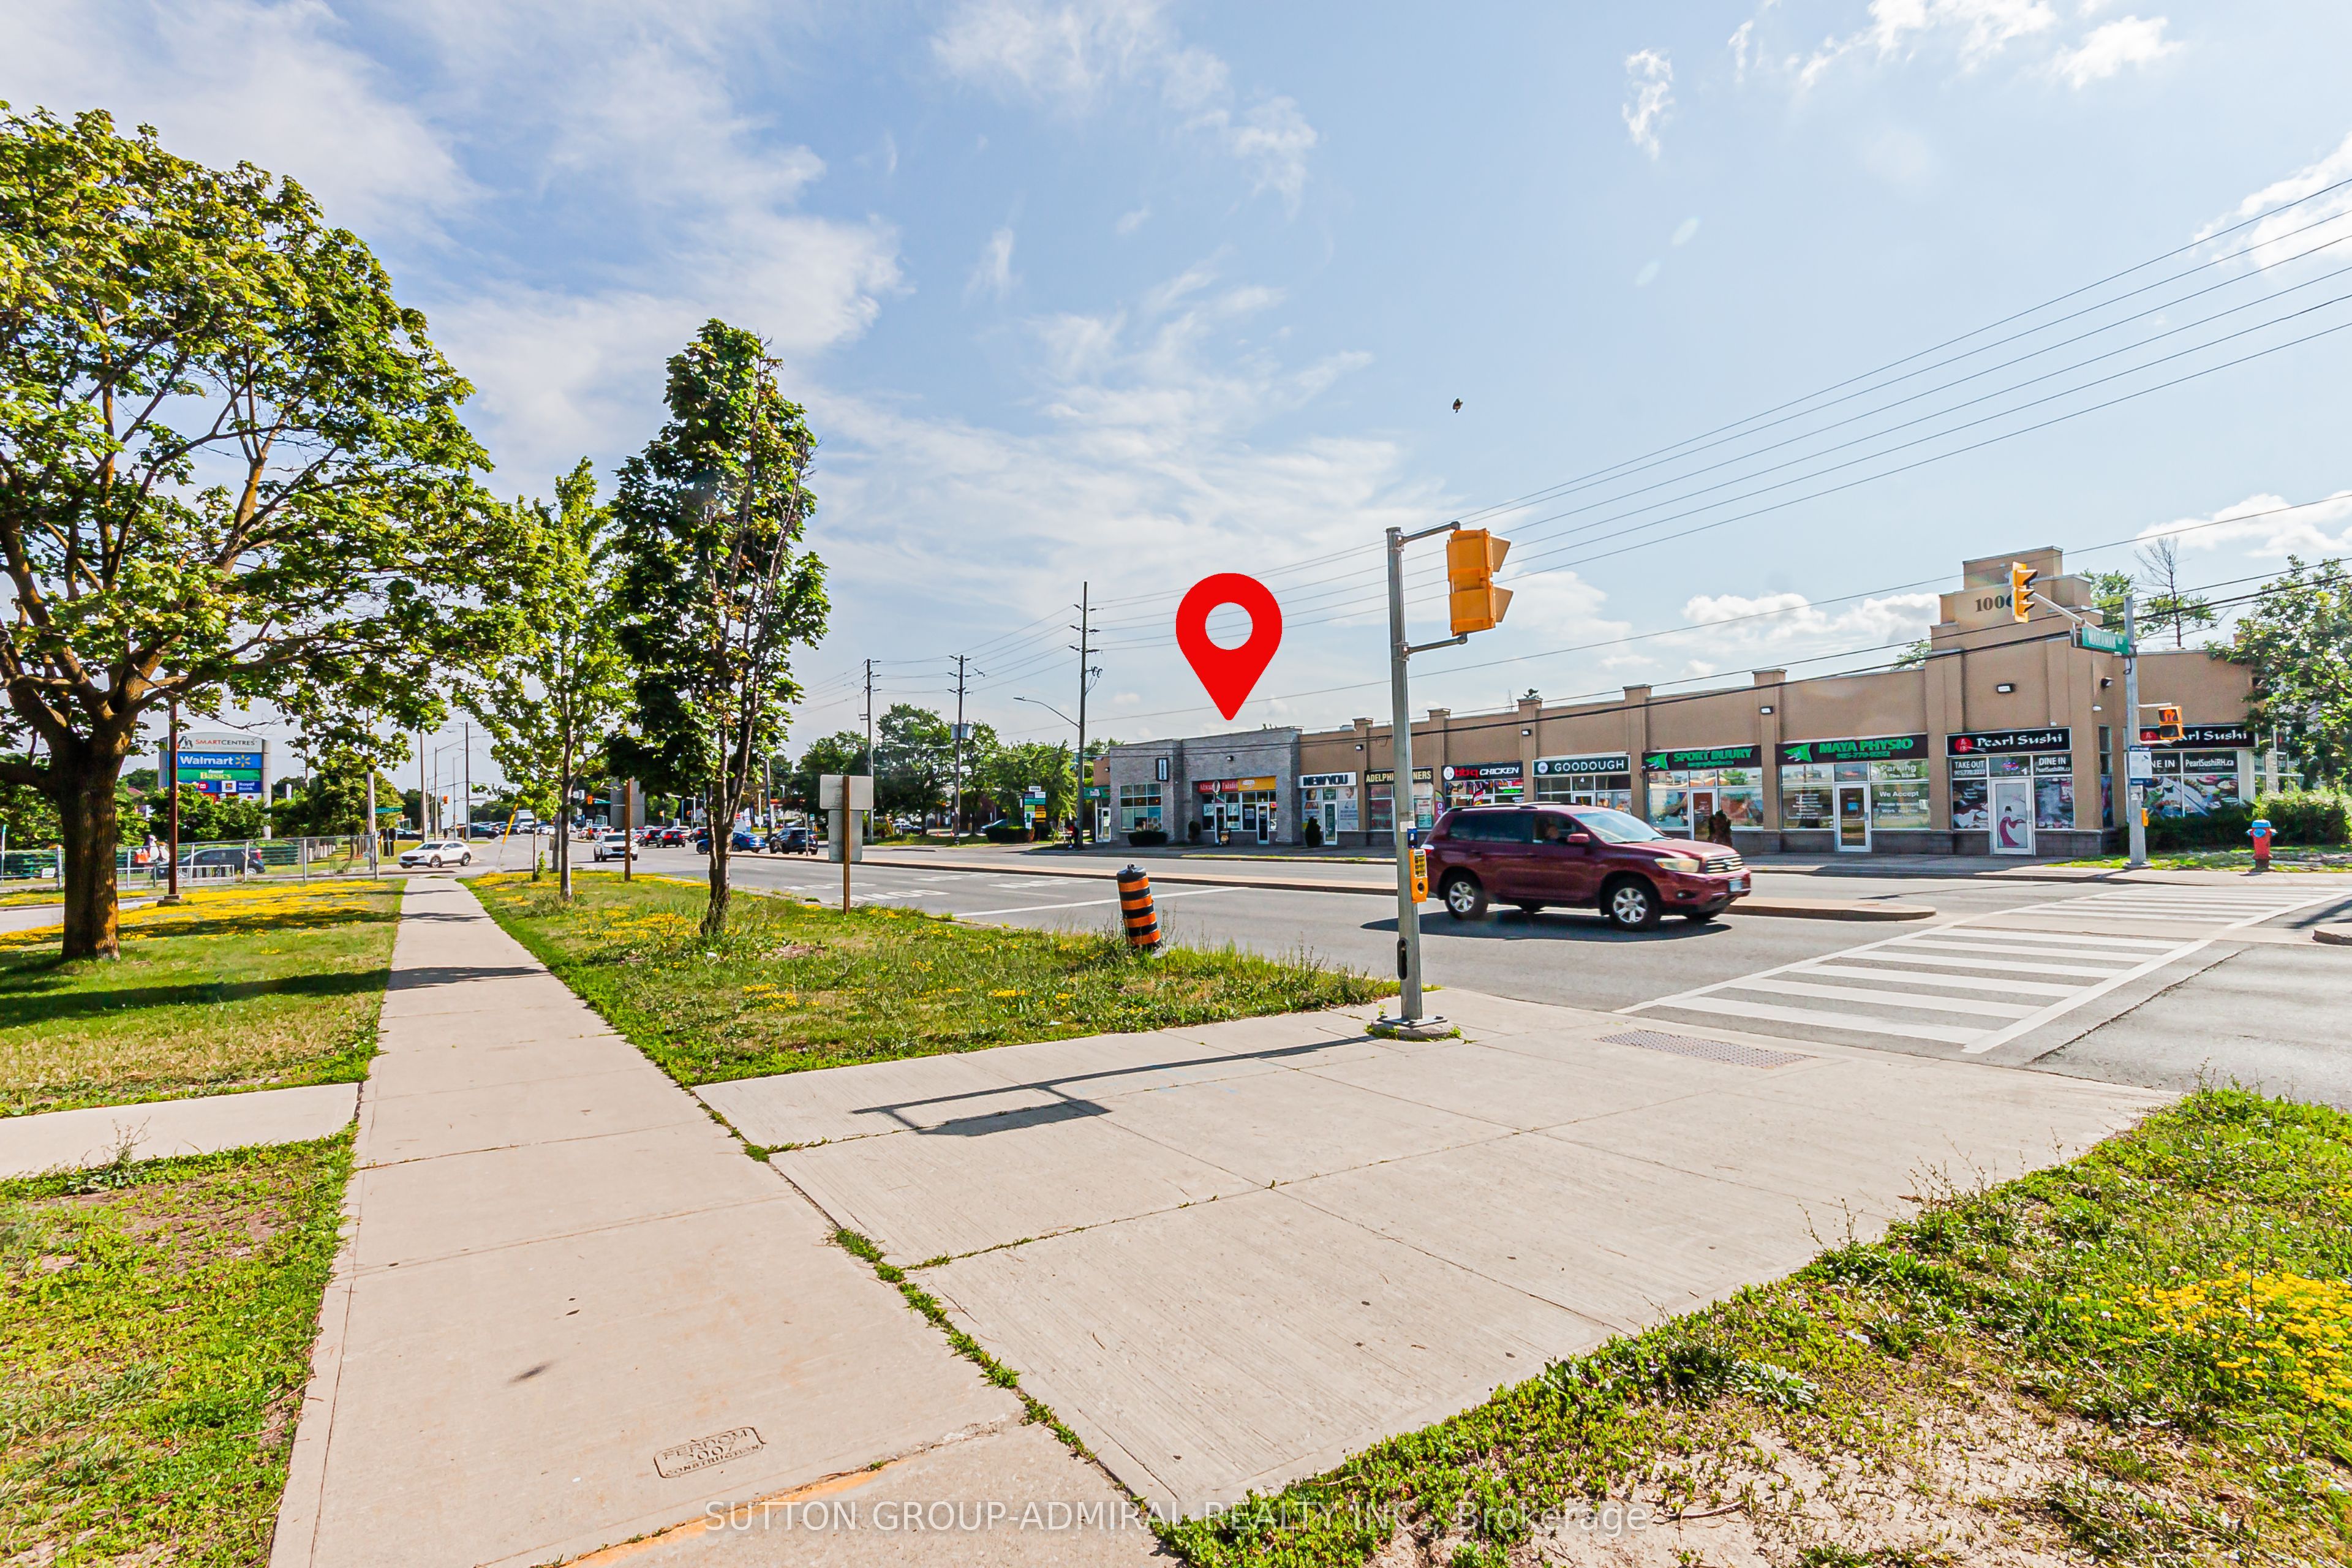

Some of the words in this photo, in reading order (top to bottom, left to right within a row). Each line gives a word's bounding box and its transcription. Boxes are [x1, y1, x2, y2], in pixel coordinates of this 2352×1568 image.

[1977, 735, 2014, 747] Pearl
[2018, 733, 2062, 745] Sushi
[2204, 729, 2247, 741] Sushi
[1819, 742, 1858, 753] MAYA
[1860, 738, 1913, 752] PHYSIO
[179, 755, 233, 765] Walmart
[1673, 751, 1709, 762] SPORT
[2038, 757, 2057, 766] DINE
[1554, 760, 1624, 772] GOODOUGH
[1881, 763, 1917, 772] Parking
[1970, 760, 1985, 769] OUT
[1479, 766, 1520, 775] CHICKEN
[1366, 773, 1394, 783] ADELPHI
[838, 889, 950, 902] DOWN
